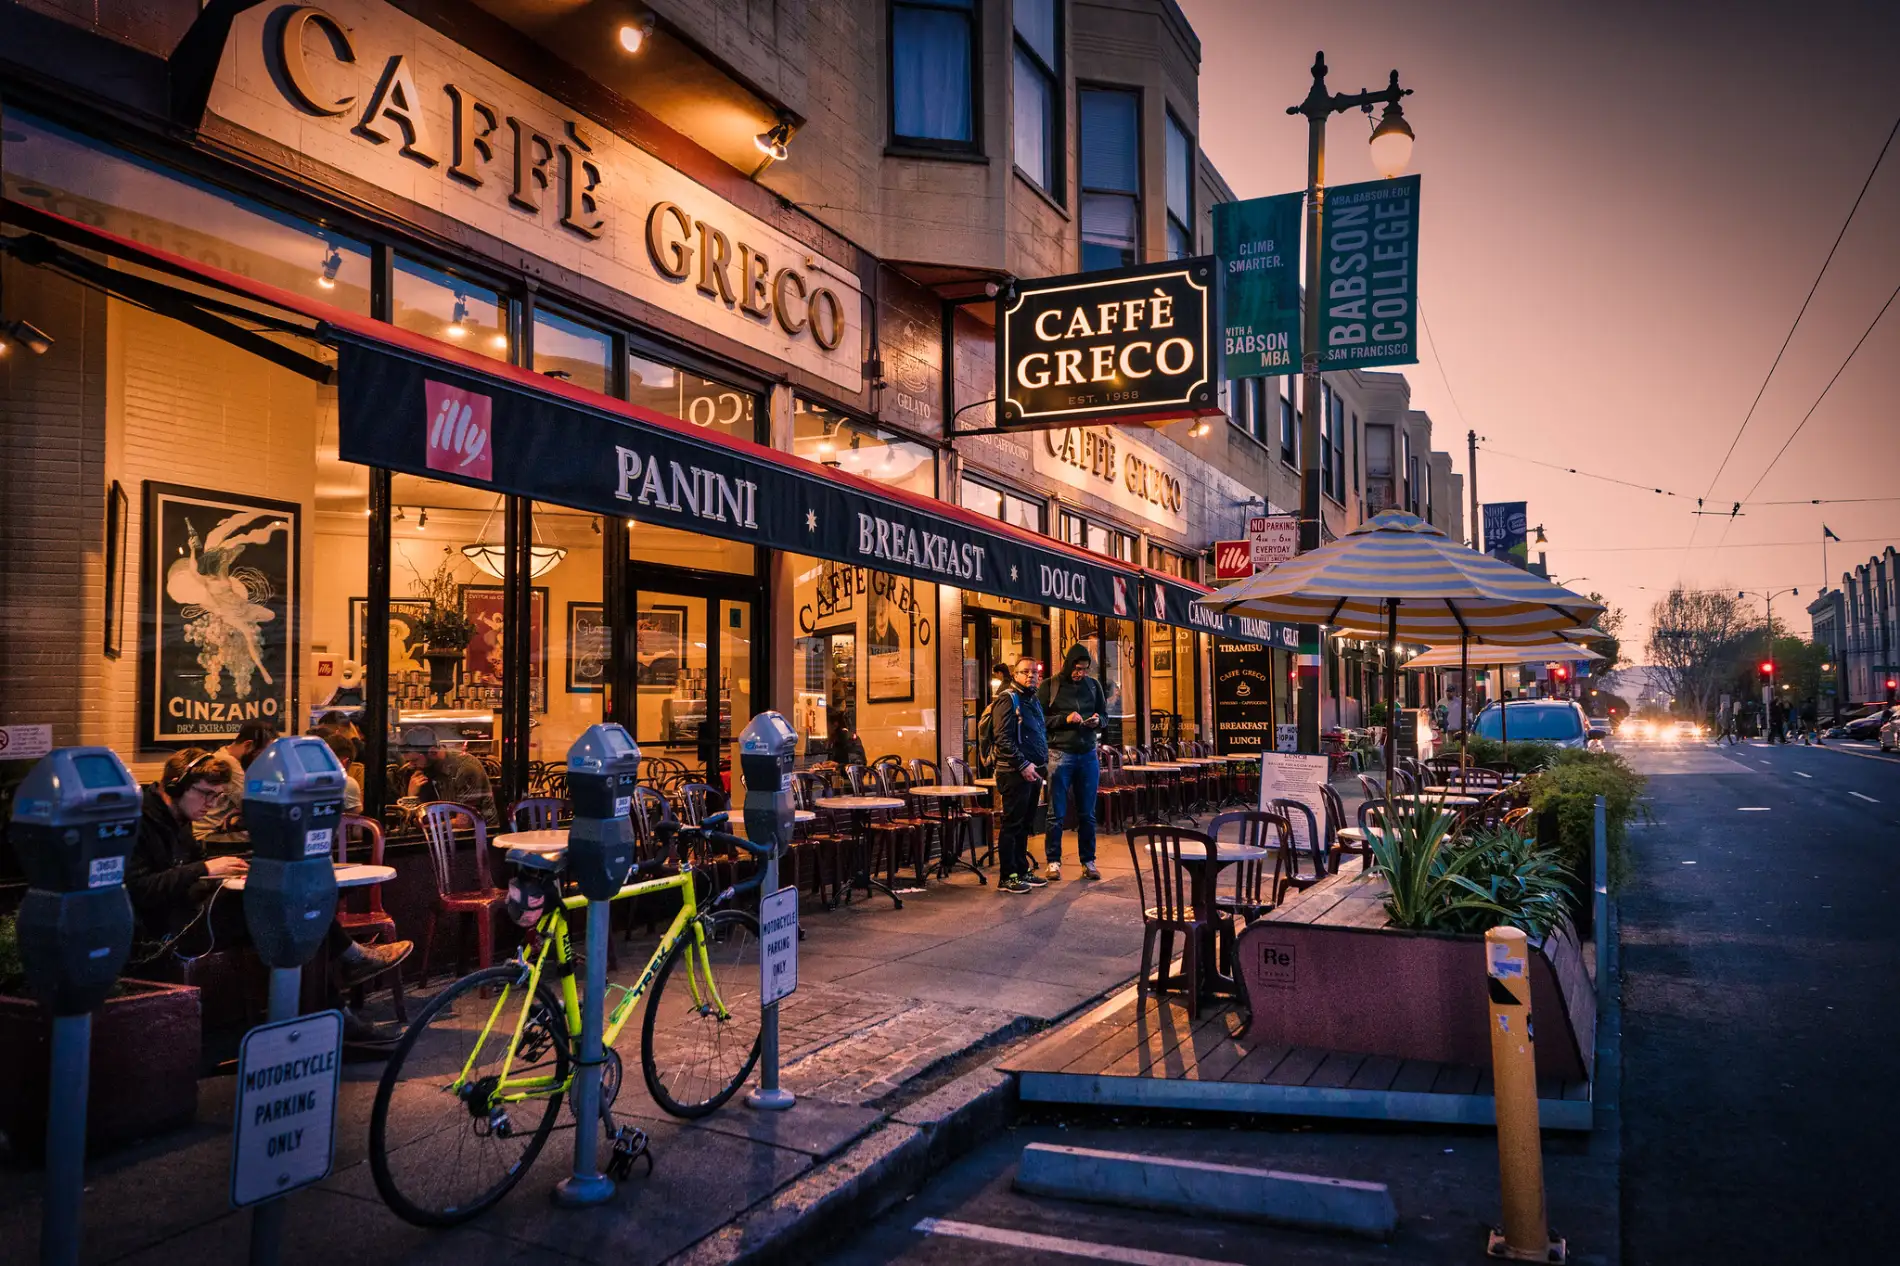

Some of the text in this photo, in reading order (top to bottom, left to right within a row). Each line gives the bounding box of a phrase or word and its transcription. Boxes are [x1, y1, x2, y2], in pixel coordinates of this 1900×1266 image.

[277, 7, 845, 351] CAFFÈ GRECO
[1332, 186, 1411, 206] MBA.BABSON.EDU
[1240, 240, 1274, 256] CLIMB
[1229, 256, 1285, 273] SMARTER.
[1329, 204, 1369, 346] BABSON
[1371, 198, 1410, 342] COLLEGE
[1035, 288, 1174, 341] CAFFÈ
[1247, 326, 1252, 334] A
[1225, 332, 1288, 356] BABSON
[1328, 343, 1408, 361] SAN FRANCISCO
[1017, 338, 1194, 389] GRECO
[1261, 351, 1290, 367] MBA
[897, 393, 930, 419] GELATO
[1069, 391, 1139, 405] EST. 1988
[431, 399, 488, 467] illy
[615, 445, 758, 529] PANINI
[1124, 453, 1182, 512] GRECO
[1252, 520, 1294, 531] NO PARKING
[858, 512, 985, 581] BREAKFAST
[1219, 547, 1250, 573] illy
[1040, 565, 1087, 604] DOLCI
[1240, 616, 1271, 641] TIRAMISU
[1283, 627, 1299, 647] GELAT
[1219, 644, 1262, 652] TIRAMISU
[1242, 670, 1266, 682] GRECO
[169, 696, 277, 721] CINZANO
[200, 724, 224, 733] EXTRA
[226, 723, 243, 732] DRY
[1220, 722, 1268, 730] BREAKFAST
[763, 912, 795, 936] MOTORCYCLE
[767, 936, 790, 956] PARKING
[1264, 948, 1290, 965] Re
[633, 945, 669, 998] TREK
[773, 960, 786, 976] ONLY
[245, 1051, 335, 1093] MOTORCYCLE
[255, 1090, 316, 1126] PARKING
[267, 1128, 304, 1158] ONLY
